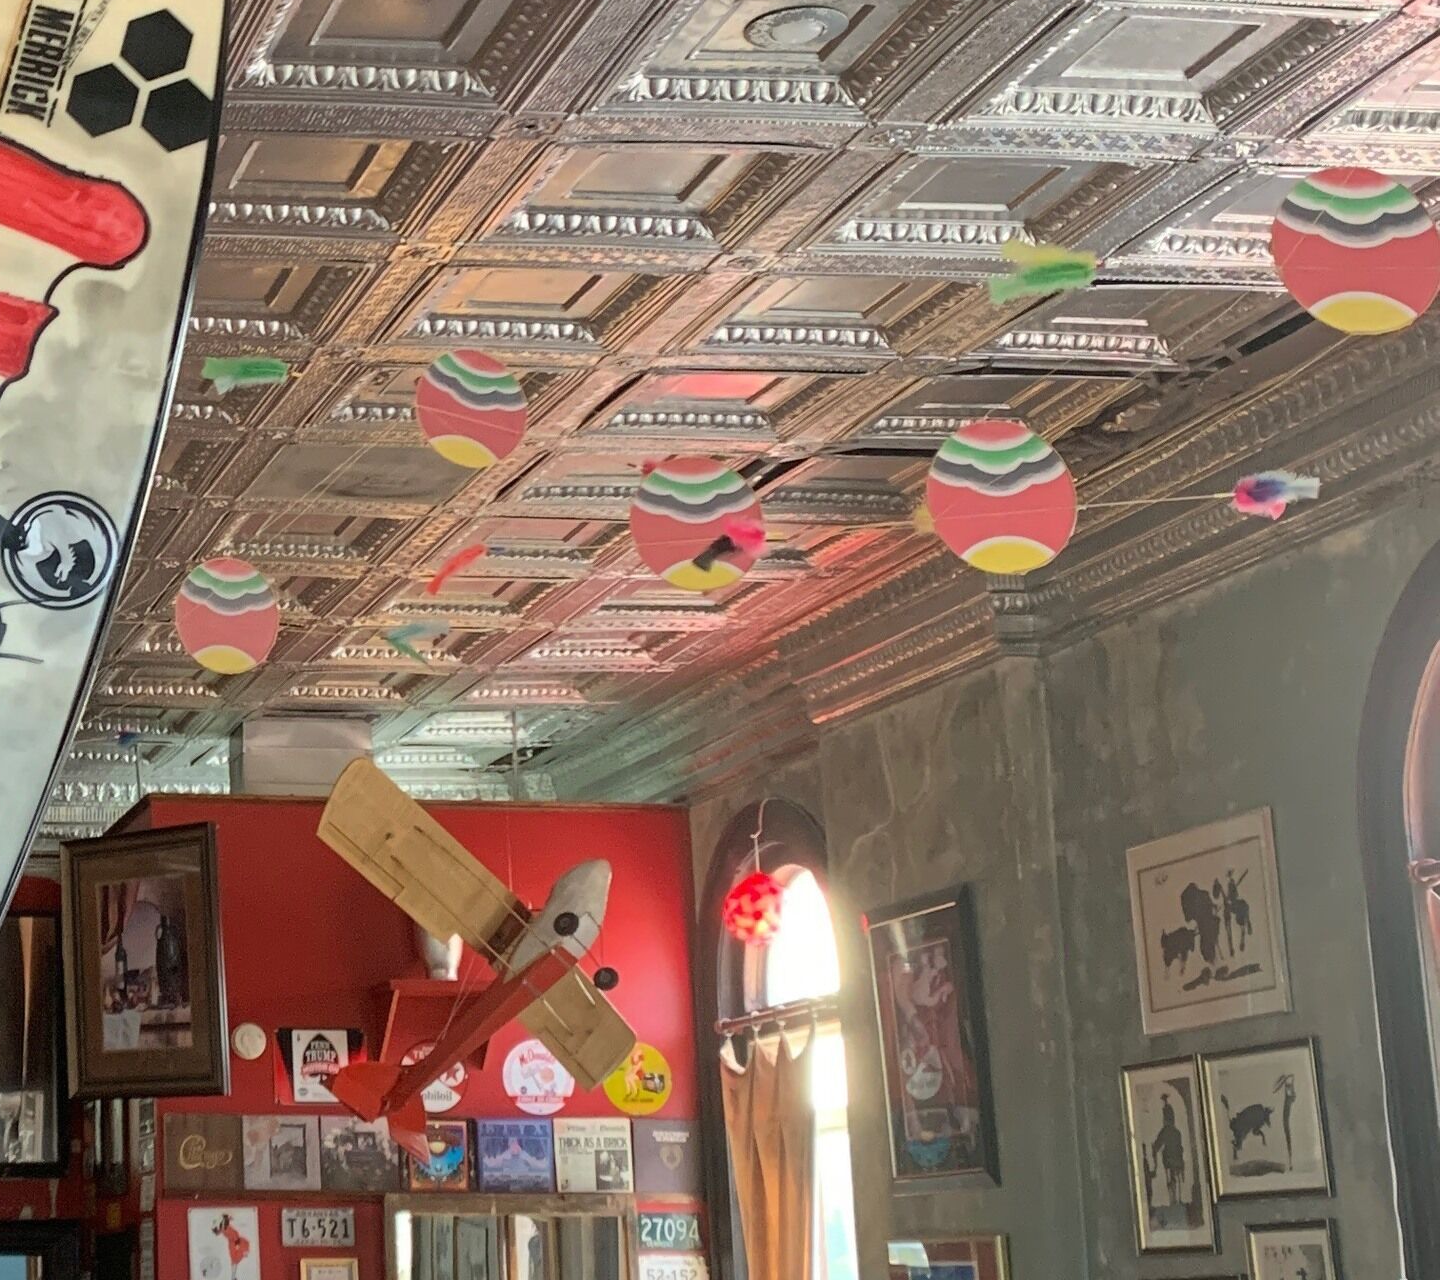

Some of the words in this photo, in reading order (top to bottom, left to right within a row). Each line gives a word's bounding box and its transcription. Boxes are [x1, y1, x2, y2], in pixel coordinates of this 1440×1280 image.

[5, 4, 76, 122] MERRICK
[305, 1049, 337, 1063] TRUMP
[559, 1136, 581, 1149] THICK
[583, 1137, 595, 1149] AS
[596, 1137, 602, 1149] A
[603, 1137, 628, 1149] BRICK
[640, 1218, 699, 1242] 27094
